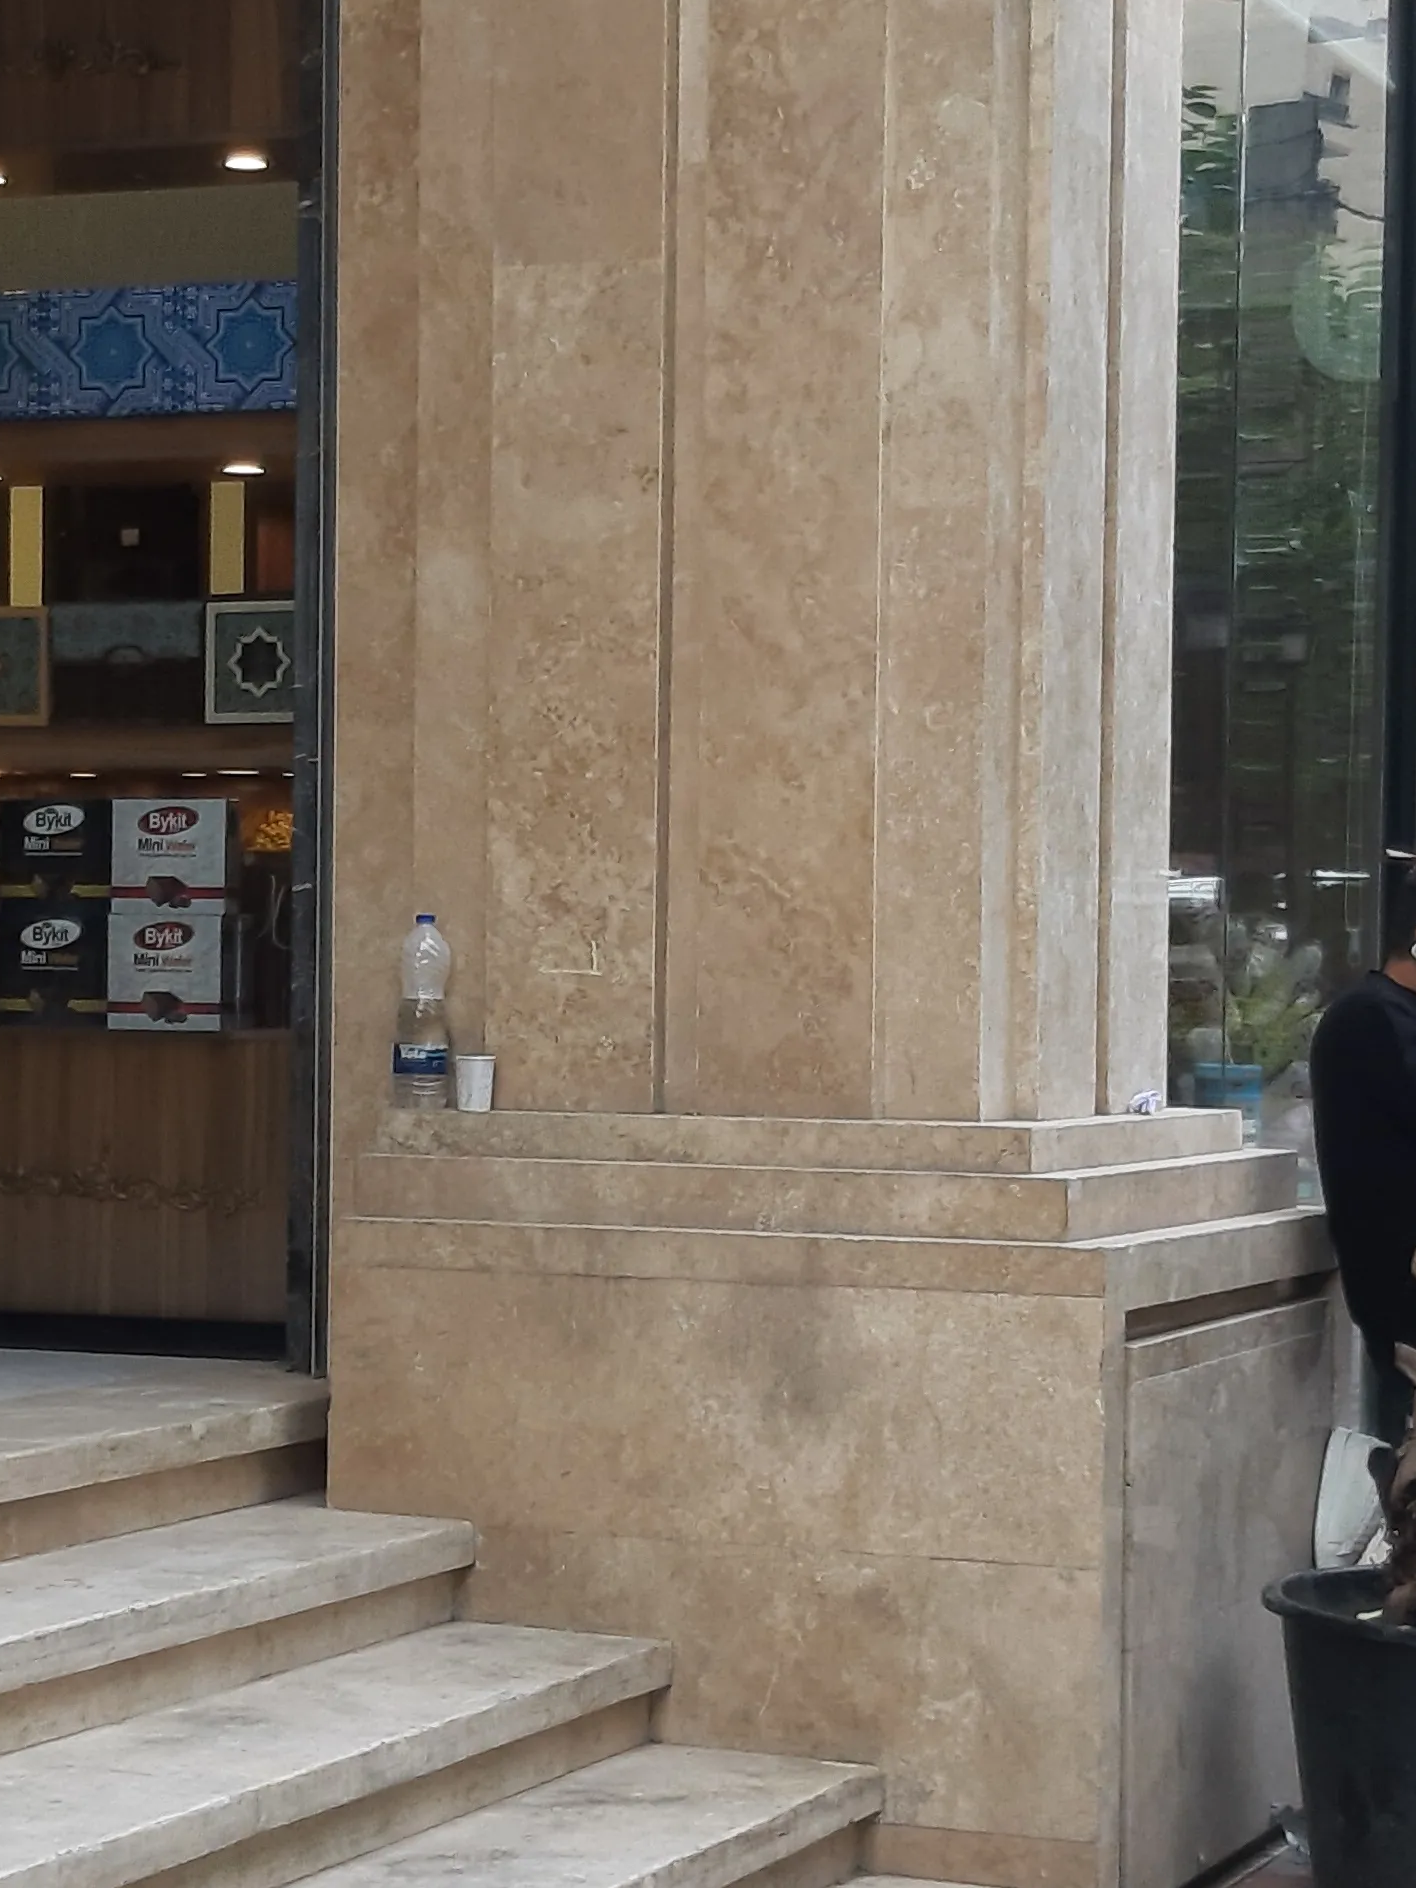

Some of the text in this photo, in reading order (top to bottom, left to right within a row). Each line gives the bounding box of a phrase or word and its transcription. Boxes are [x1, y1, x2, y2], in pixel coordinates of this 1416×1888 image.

[36, 811, 72, 831] Bykit
[149, 812, 187, 832] Bykit
[24, 836, 50, 850] Mini
[138, 838, 163, 852] Mini
[33, 927, 68, 946] Bykit
[144, 927, 183, 947] Bykit
[21, 951, 46, 965] Mini
[134, 953, 159, 967] Mini
